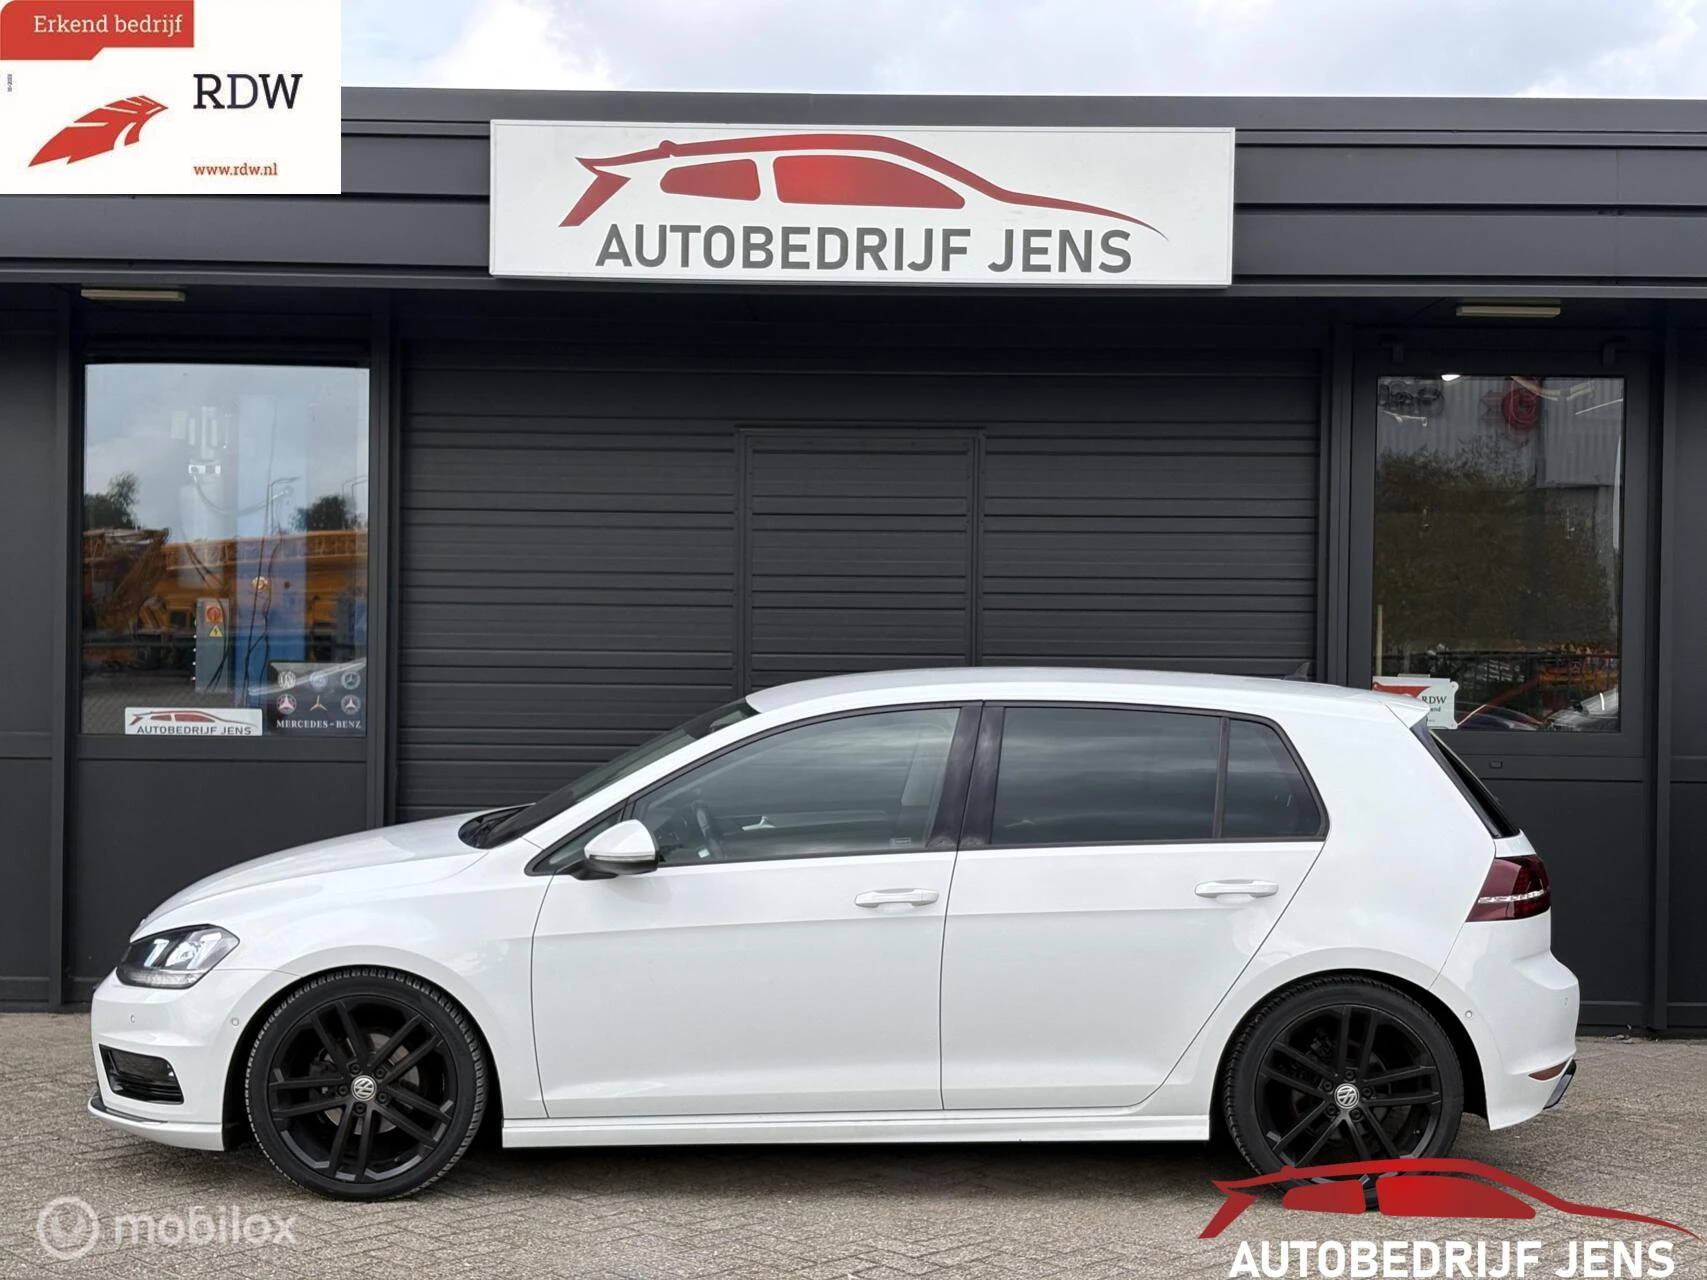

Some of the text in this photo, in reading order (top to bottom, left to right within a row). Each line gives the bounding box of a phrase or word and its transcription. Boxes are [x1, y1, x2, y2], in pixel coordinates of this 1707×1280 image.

[595, 223, 1132, 273] AUTOBEDRIJF JENS
[137, 725, 252, 736] AUTOBEDRIJF JENS
